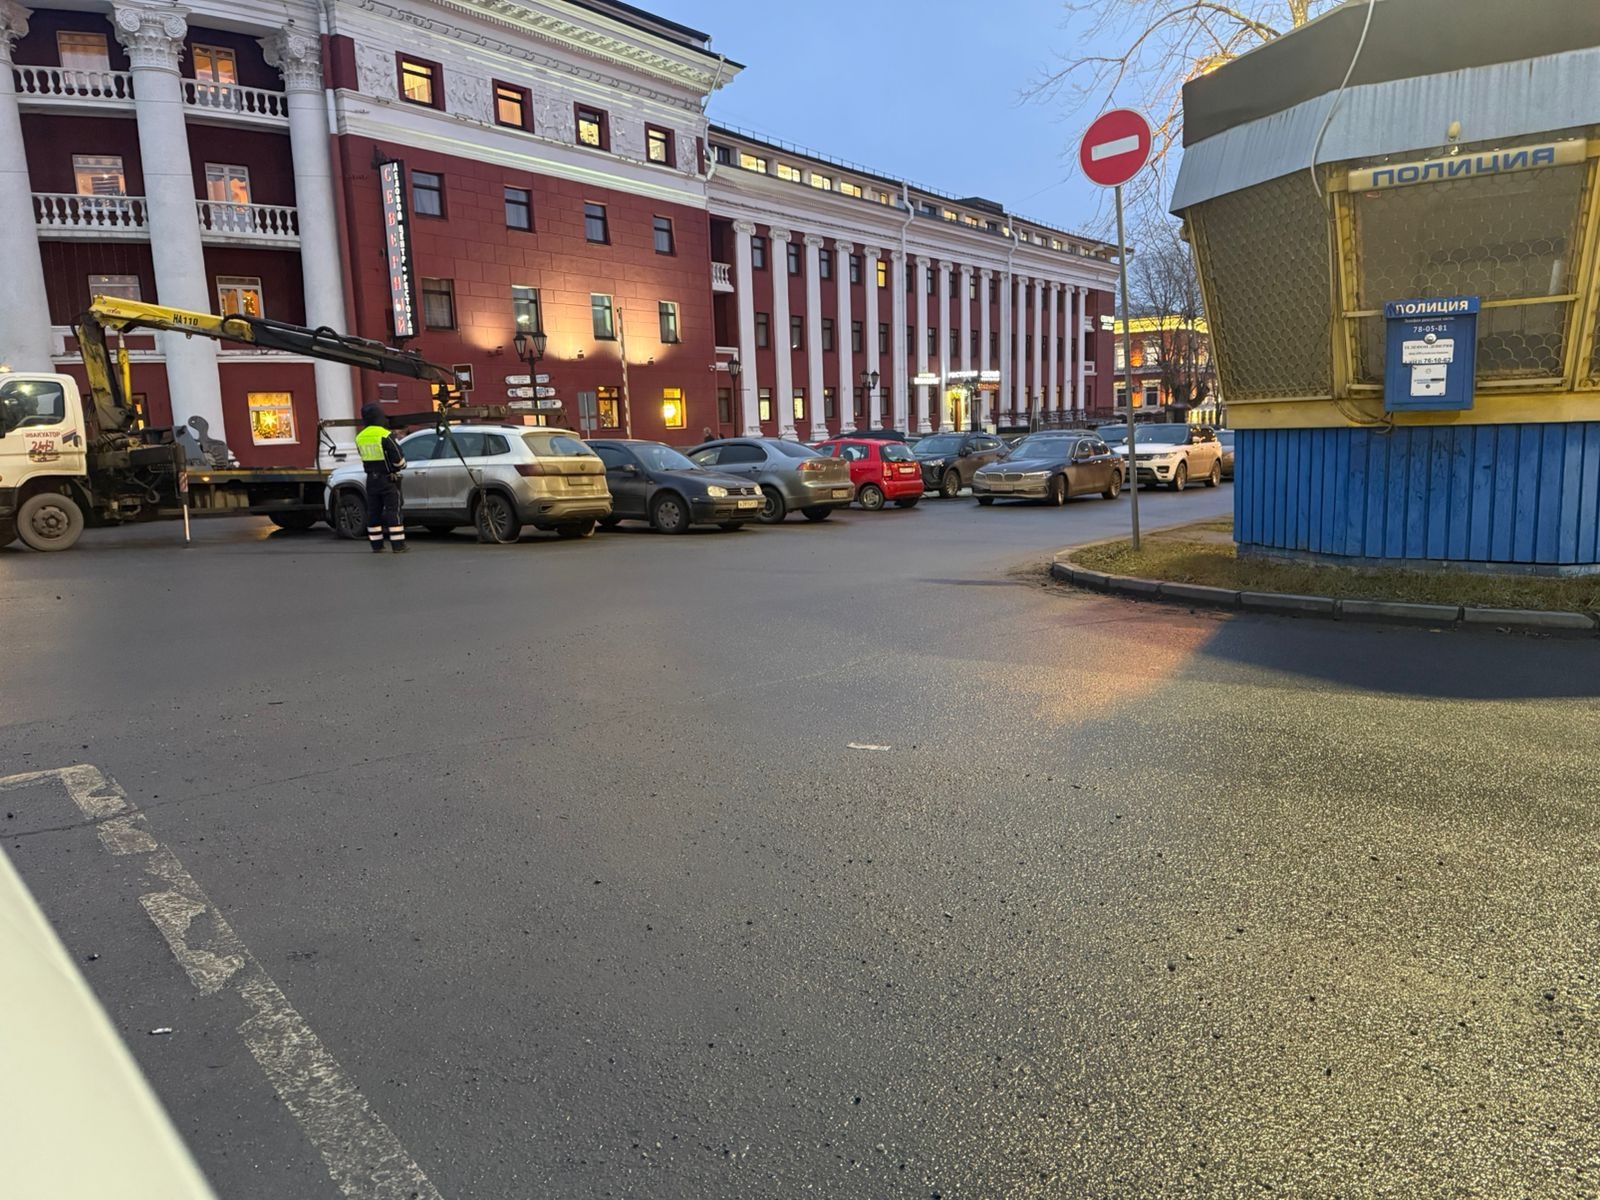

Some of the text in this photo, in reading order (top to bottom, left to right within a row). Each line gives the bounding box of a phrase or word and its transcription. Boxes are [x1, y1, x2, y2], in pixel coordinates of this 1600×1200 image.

[1372, 146, 1556, 187] ПОЛИЦИЯ
[384, 167, 406, 334] СЕВЕРНЫЙ
[402, 274, 413, 335] РЕСТОРАН
[1395, 300, 1469, 315] ПОЛИЦИЯ
[1413, 324, 1448, 333] 78-05-81
